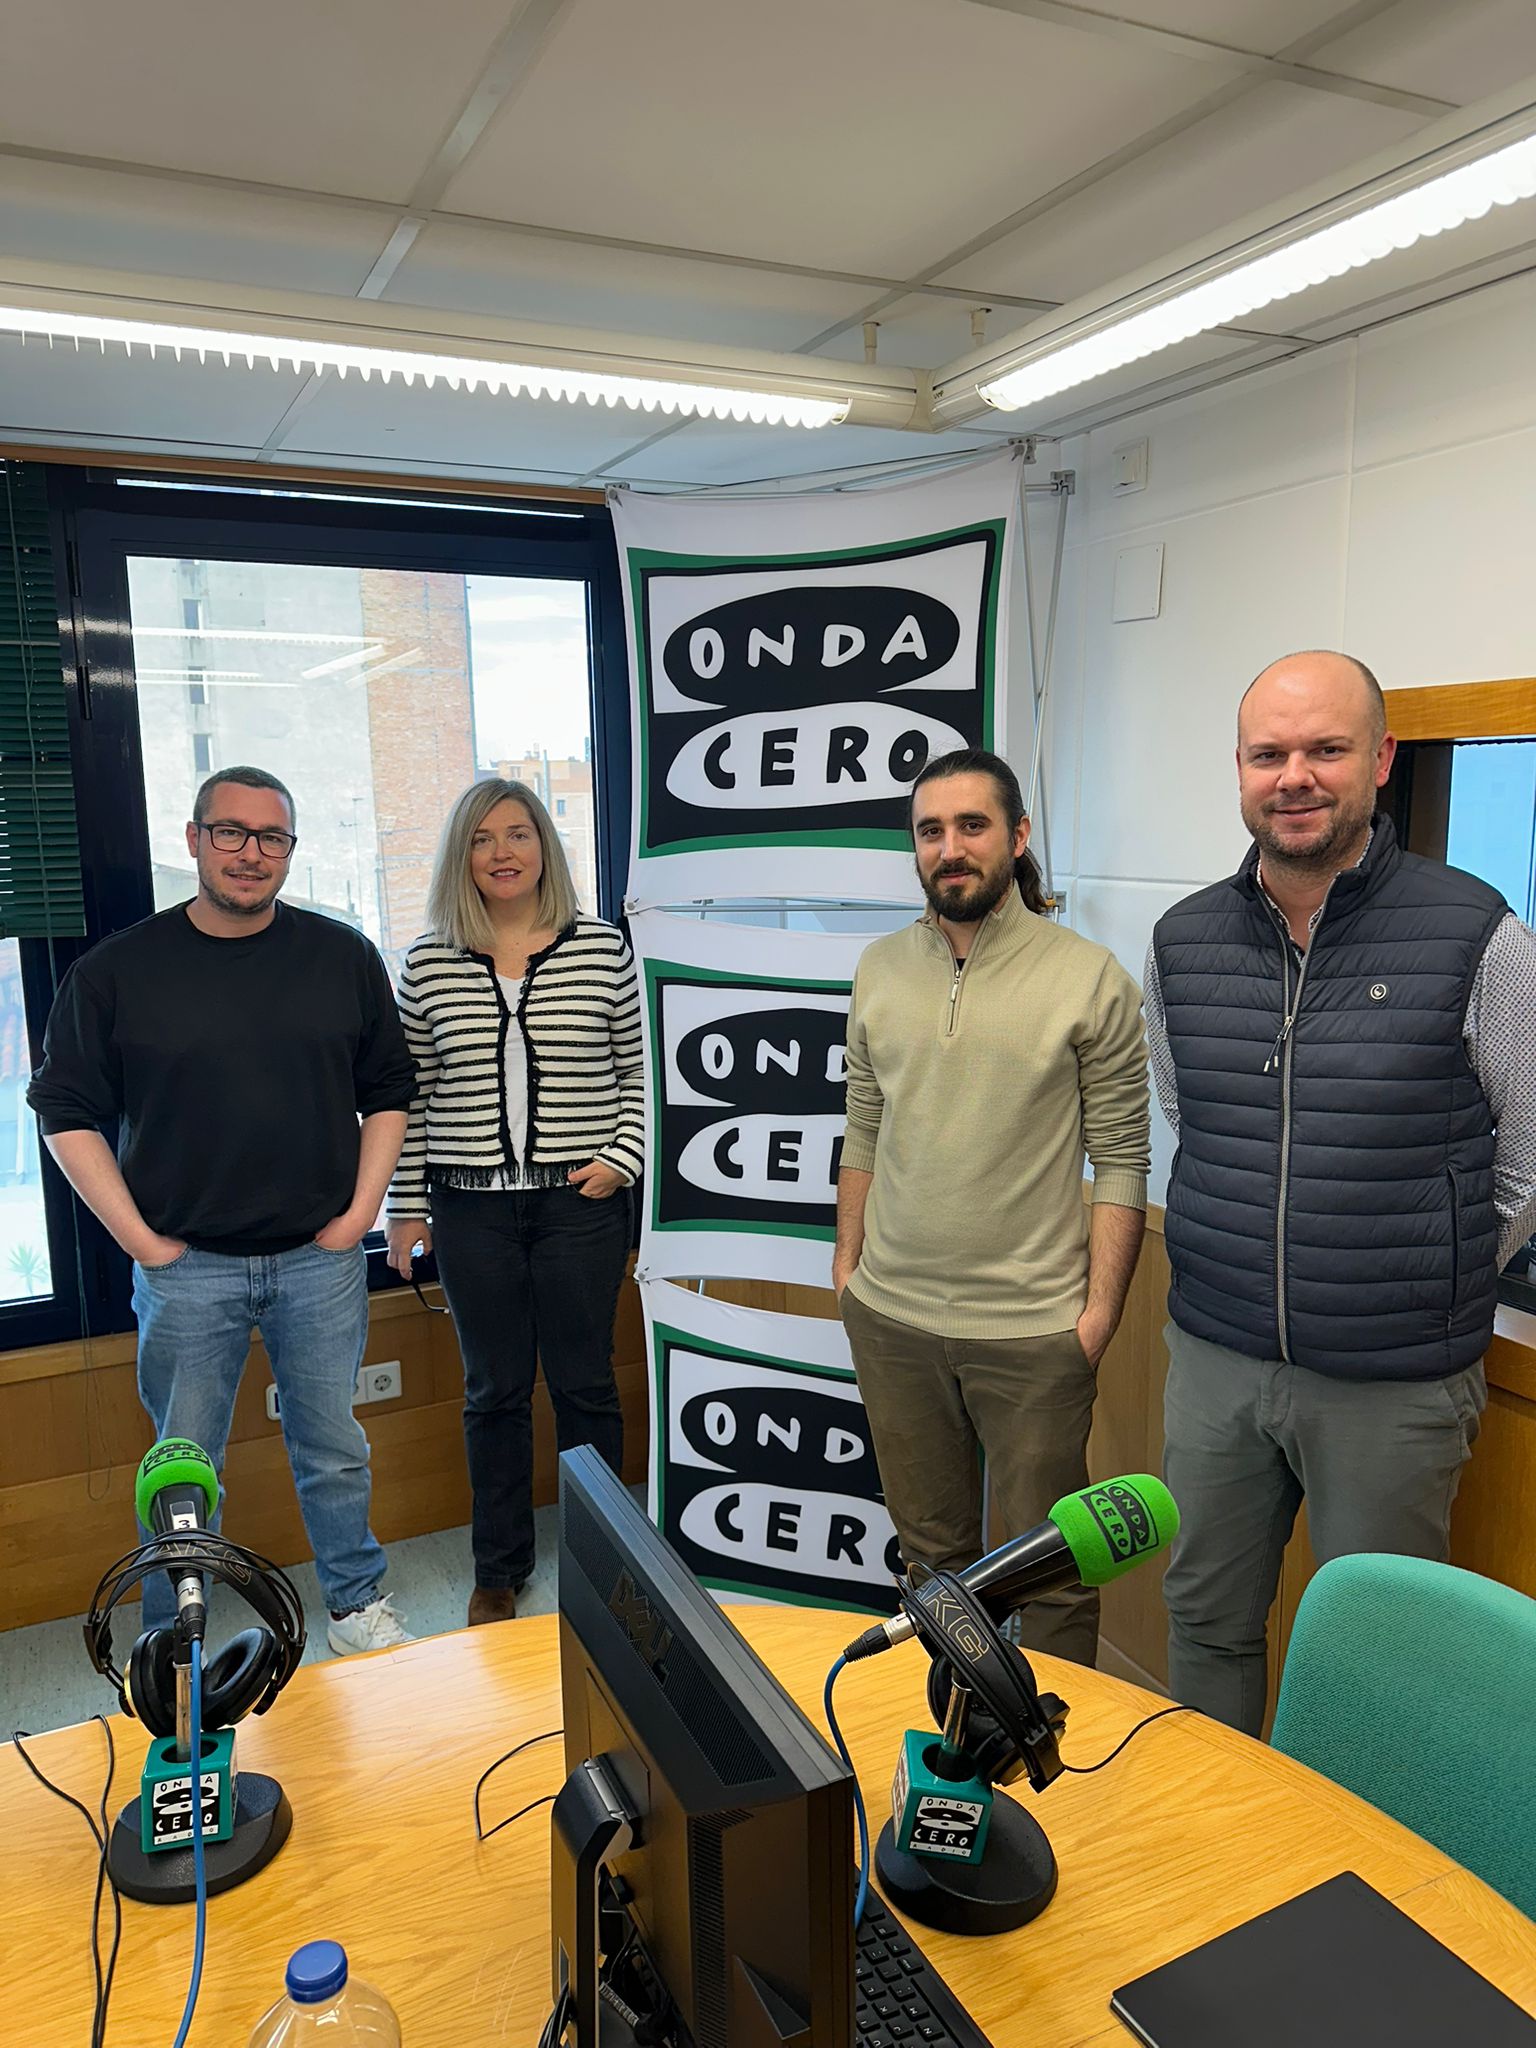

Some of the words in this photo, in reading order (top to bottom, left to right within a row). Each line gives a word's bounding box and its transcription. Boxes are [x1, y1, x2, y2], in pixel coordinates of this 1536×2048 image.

[688, 614, 928, 680] ONDA
[703, 725, 930, 790] CERO
[700, 1033, 849, 1083] OND
[713, 1127, 845, 1185] CE
[703, 1401, 866, 1464] OND
[178, 1519, 191, 1529] 3
[1095, 1497, 1129, 1548] CERO
[1112, 1488, 1147, 1540] ONDA
[160, 1775, 213, 1792] ONA
[926, 1798, 978, 1814] ONDA
[914, 1828, 968, 1847] CERO
